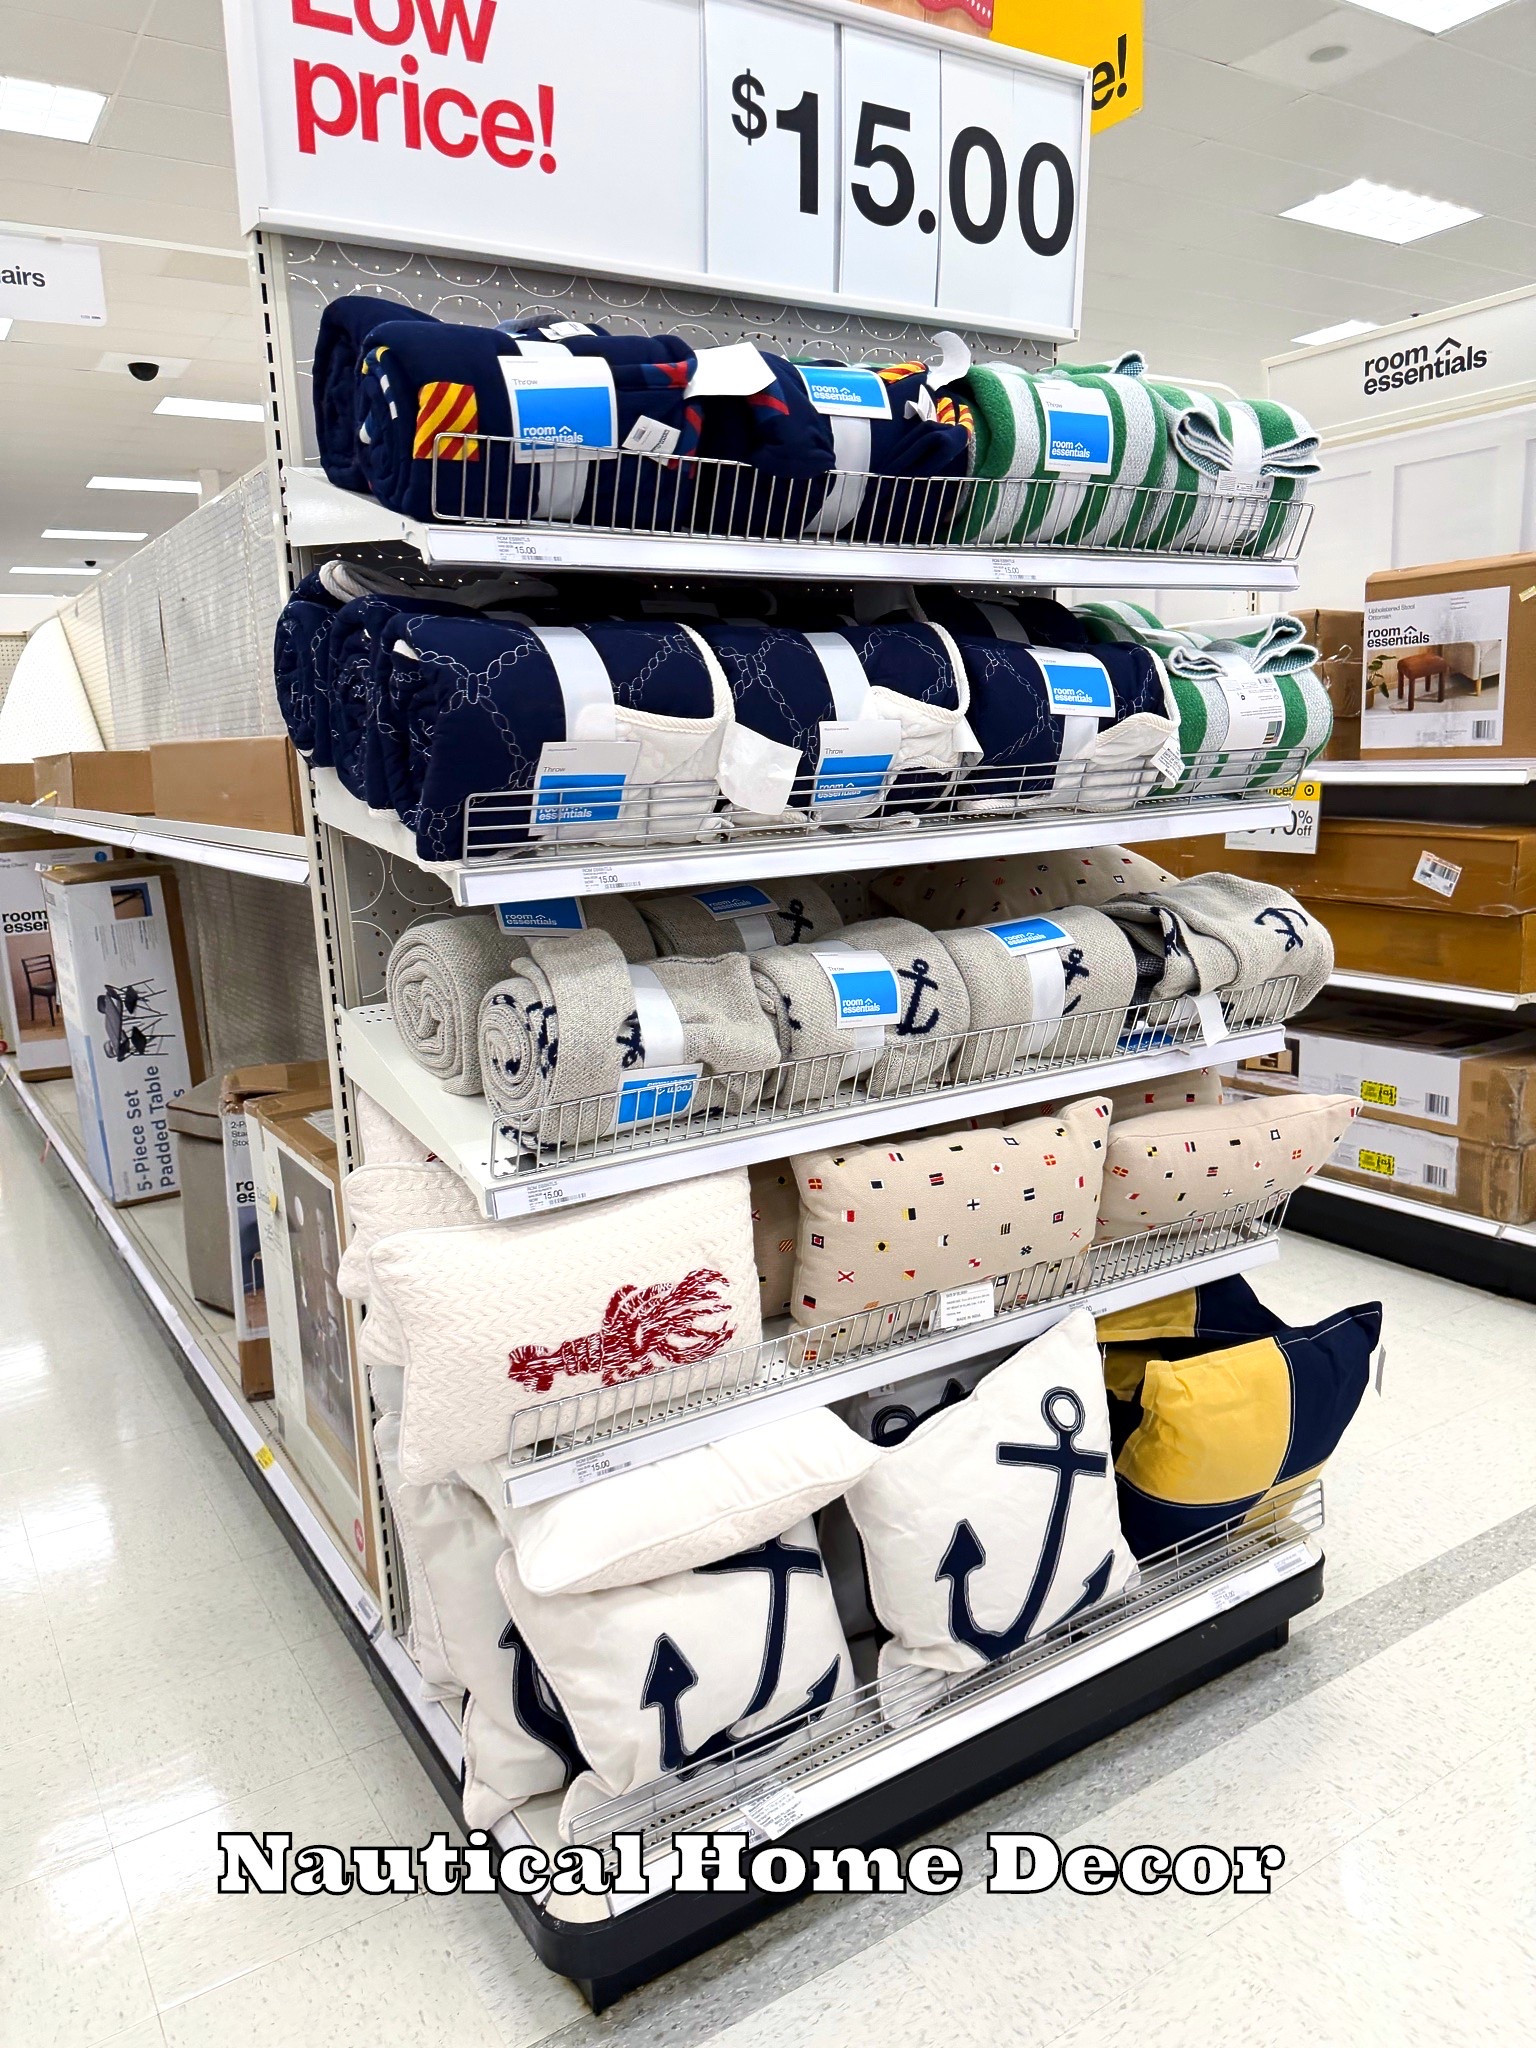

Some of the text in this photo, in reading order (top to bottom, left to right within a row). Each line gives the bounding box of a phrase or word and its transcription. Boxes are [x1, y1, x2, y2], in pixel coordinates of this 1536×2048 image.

[293, 53, 557, 175] price!
[731, 68, 1075, 257] $15.00
[0, 265, 46, 288] airs
[1364, 345, 1428, 378] room
[1363, 345, 1488, 396] essentials
[811, 384, 839, 394] room
[813, 391, 862, 403] essentials
[523, 426, 556, 437] room
[1052, 440, 1074, 450] room
[1051, 447, 1091, 459] essentials
[514, 546, 536, 555] 15.00
[1367, 626, 1401, 639] room
[1367, 632, 1430, 648] essentials
[1053, 687, 1075, 696] room
[1054, 692, 1093, 704] essentials
[1297, 826, 1312, 836] off
[599, 875, 619, 884] 15.00
[712, 899, 752, 910] essentials
[2, 910, 48, 923] room
[506, 917, 557, 926] essentials
[1003, 934, 1026, 943] room
[1007, 932, 1047, 946] essentials
[842, 998, 864, 1007] room
[843, 1003, 880, 1014] essentials
[144, 1065, 175, 1187] Padded Table
[231, 1120, 247, 1129] 2-P
[124, 1089, 153, 1192] 5-Piece Set
[543, 1190, 564, 1200] 15.00
[591, 1460, 610, 1471] 15.00
